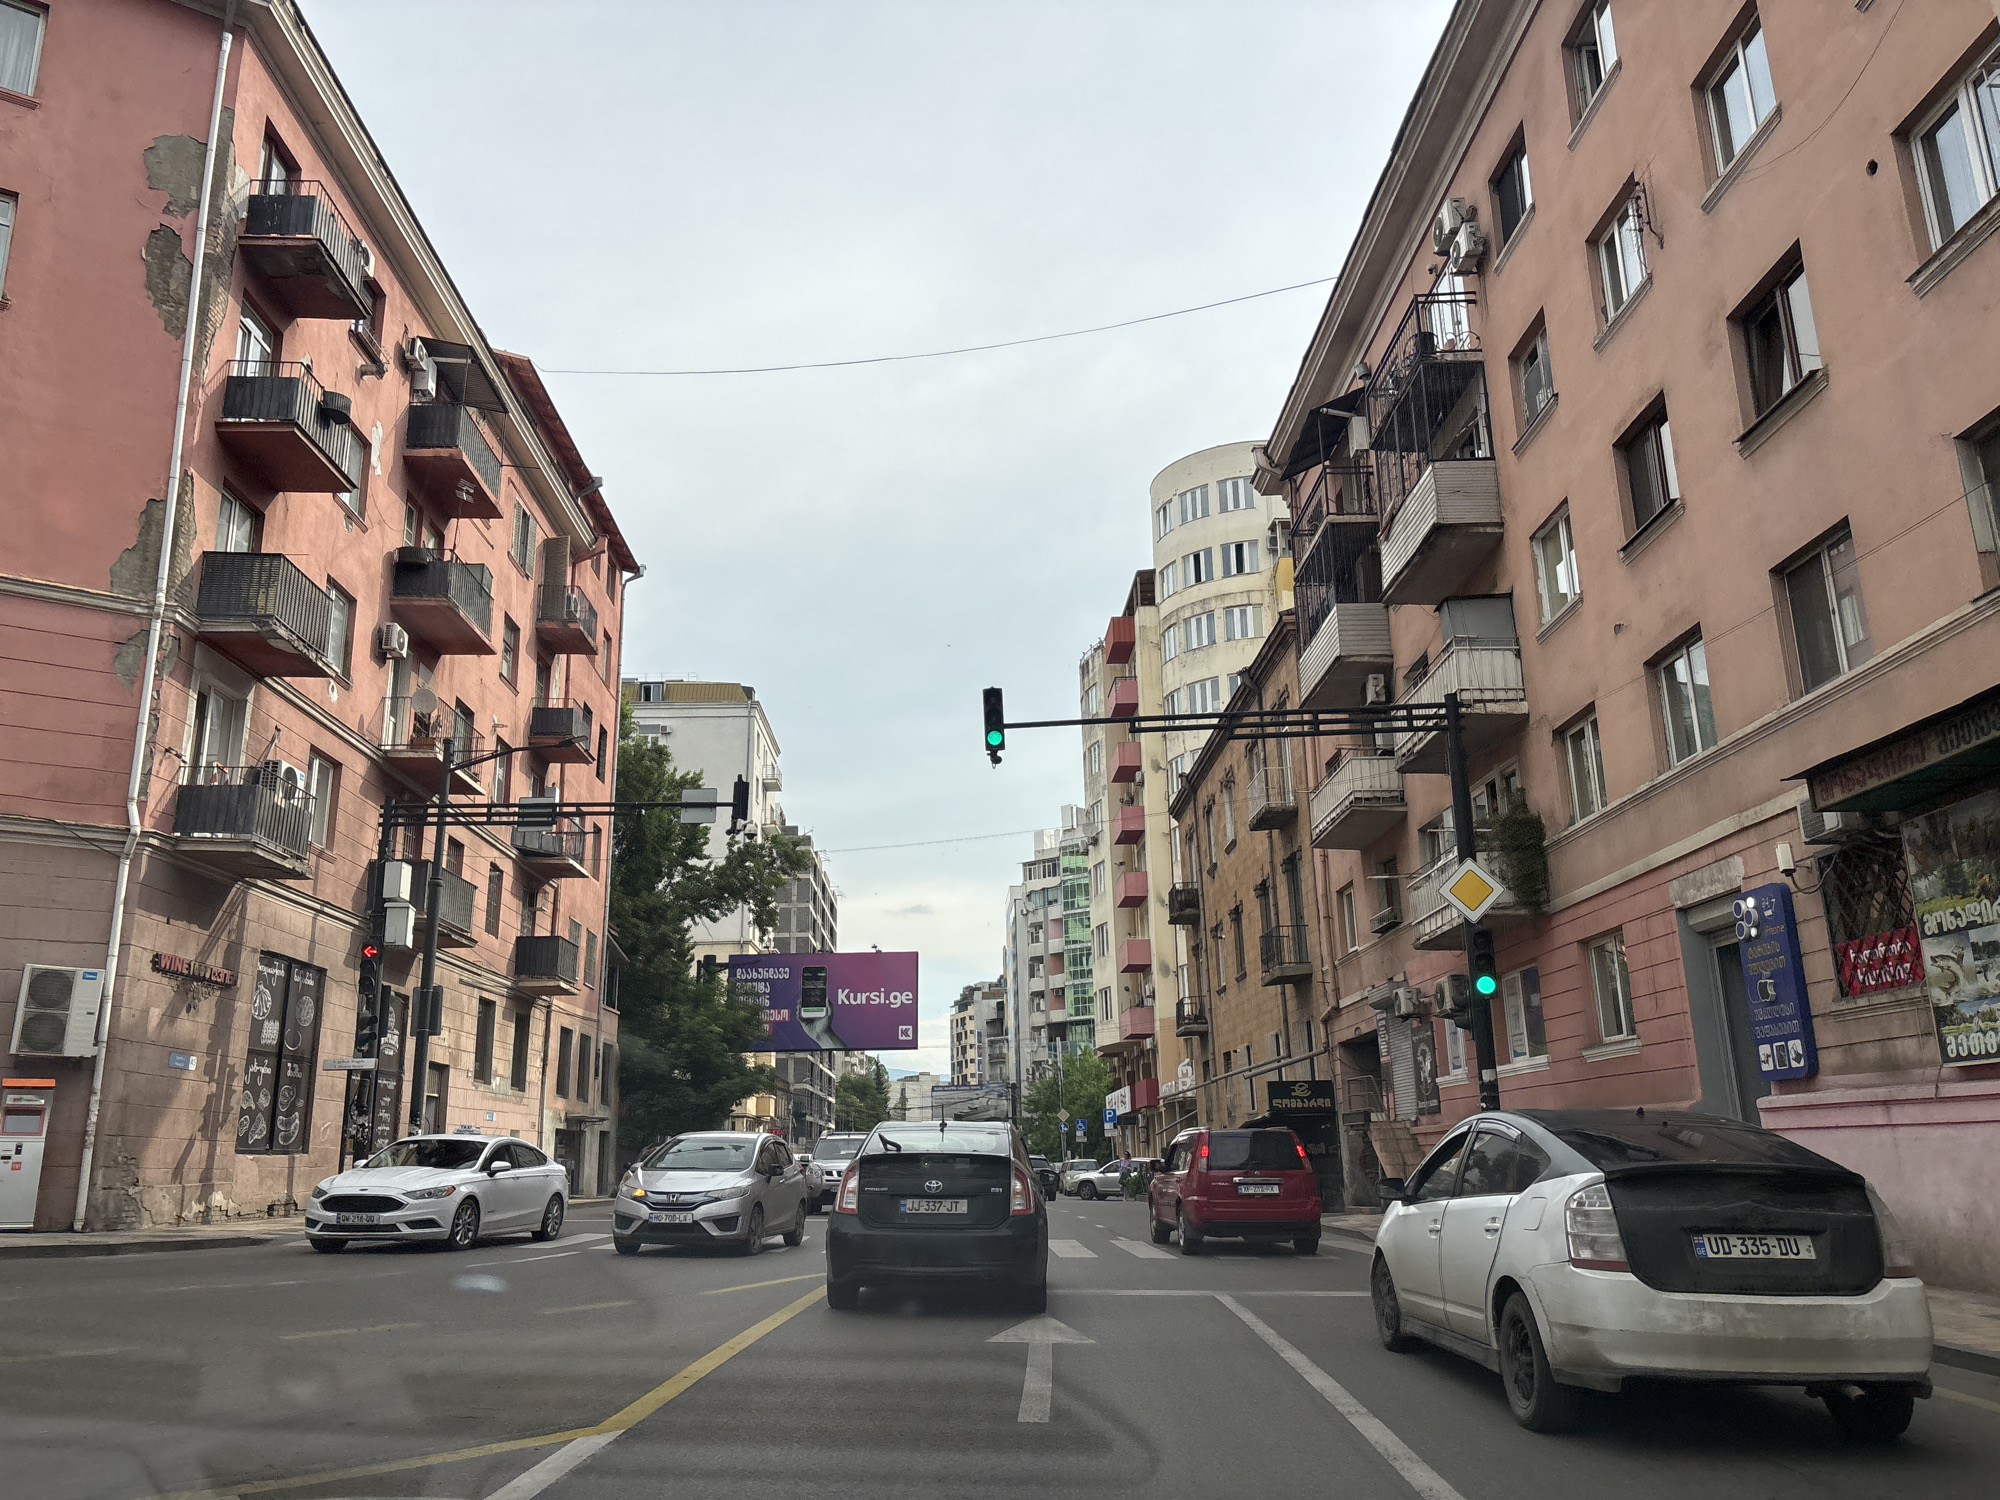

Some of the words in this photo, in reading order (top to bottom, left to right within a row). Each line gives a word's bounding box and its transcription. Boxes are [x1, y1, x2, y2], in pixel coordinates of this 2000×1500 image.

[160, 953, 189, 975] WINE
[736, 967, 790, 980] დაახურდავე
[837, 987, 913, 1009] Kursi.ge
[1272, 1098, 1331, 1108] ლომბარდი
[1105, 1110, 1114, 1121] P
[907, 1200, 960, 1213] JJ-337-JT
[1696, 1247, 1707, 1256] GE
[1707, 1236, 1800, 1256] UD-335-DU
